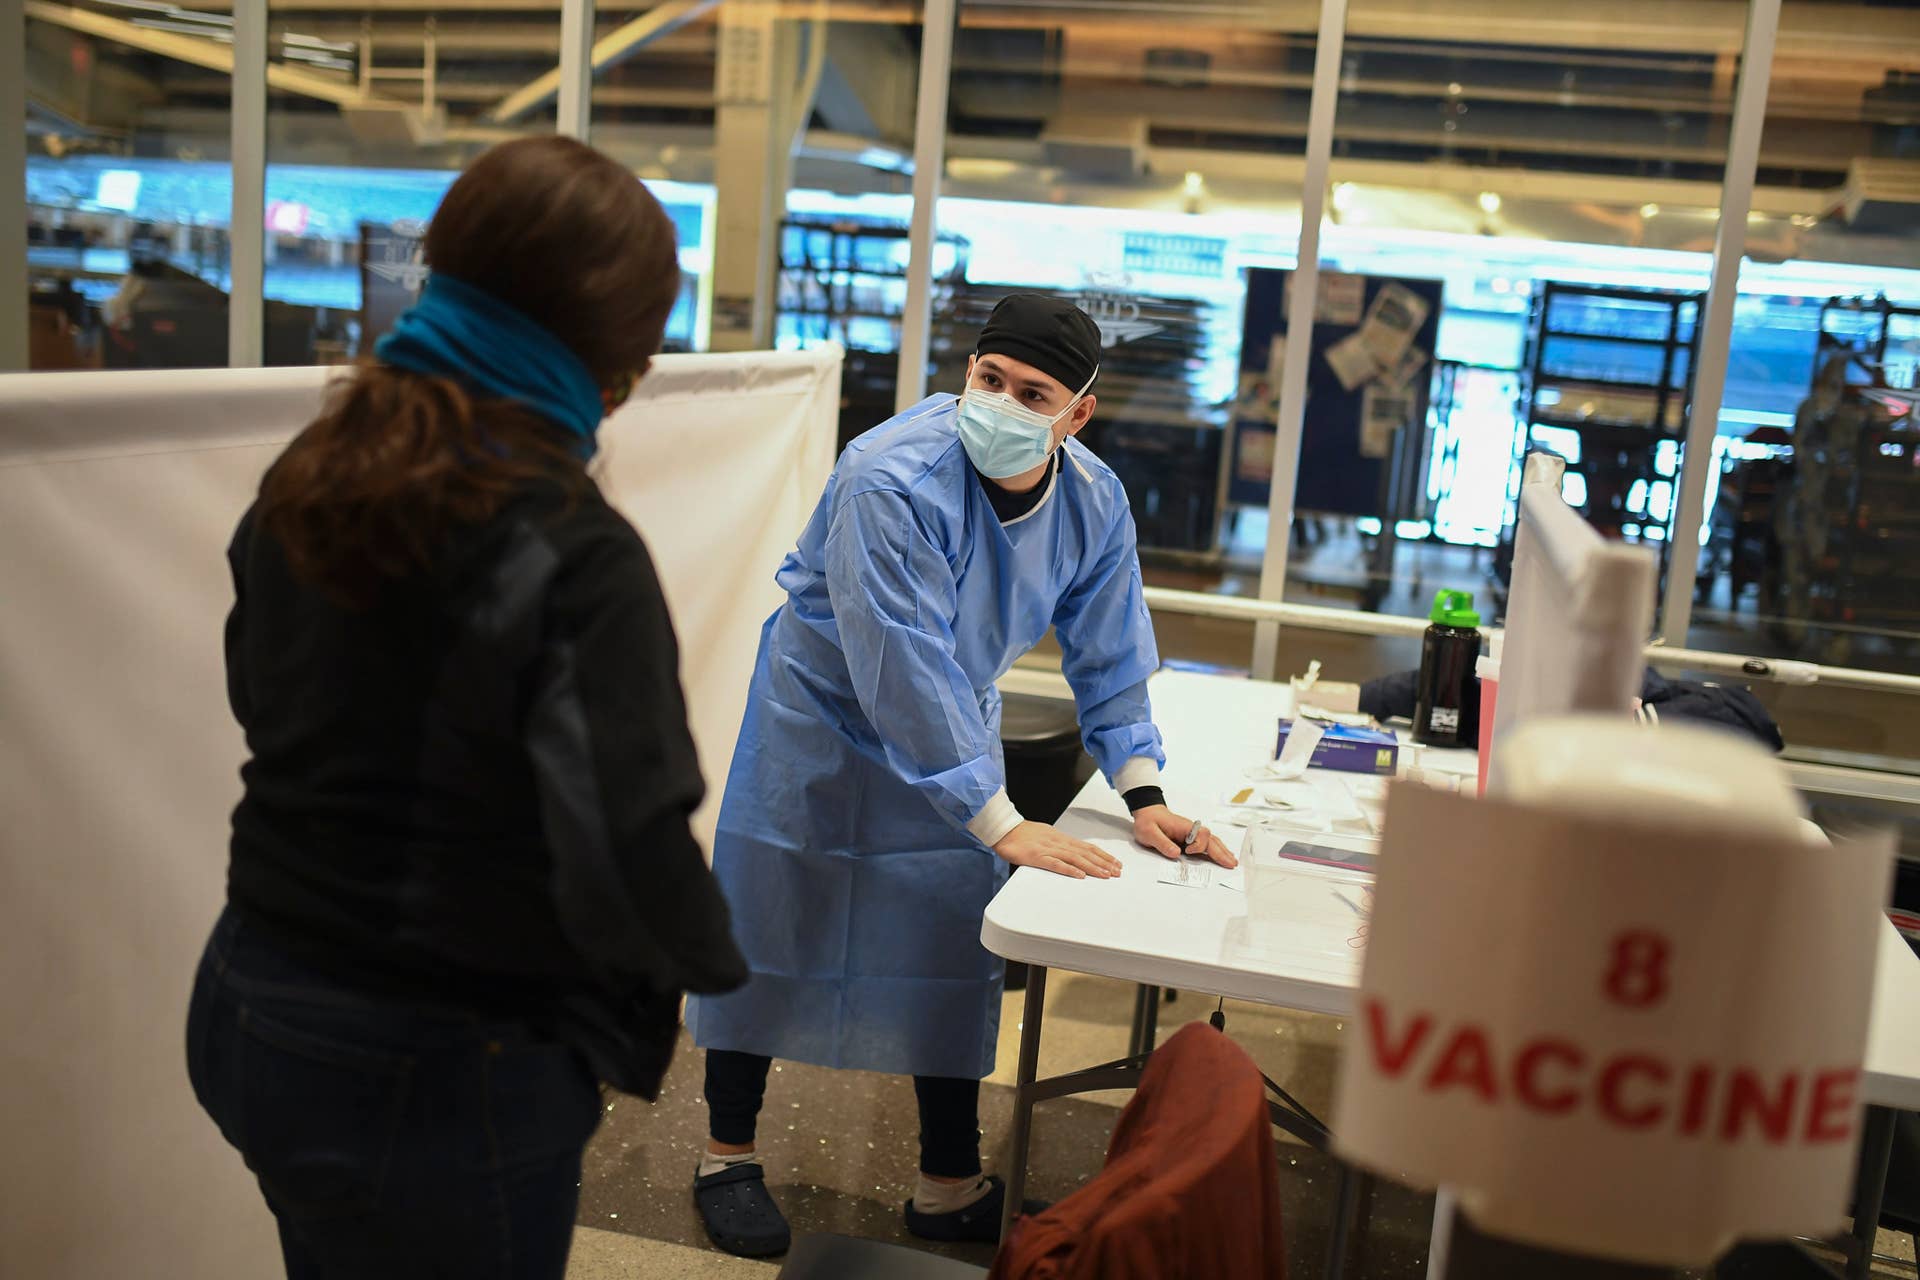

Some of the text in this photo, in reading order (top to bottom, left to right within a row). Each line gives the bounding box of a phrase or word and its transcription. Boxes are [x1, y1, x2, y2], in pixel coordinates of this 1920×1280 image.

[1378, 750, 1391, 762] M
[1605, 931, 1672, 1007] 8
[1361, 997, 1864, 1146] VACCINE
